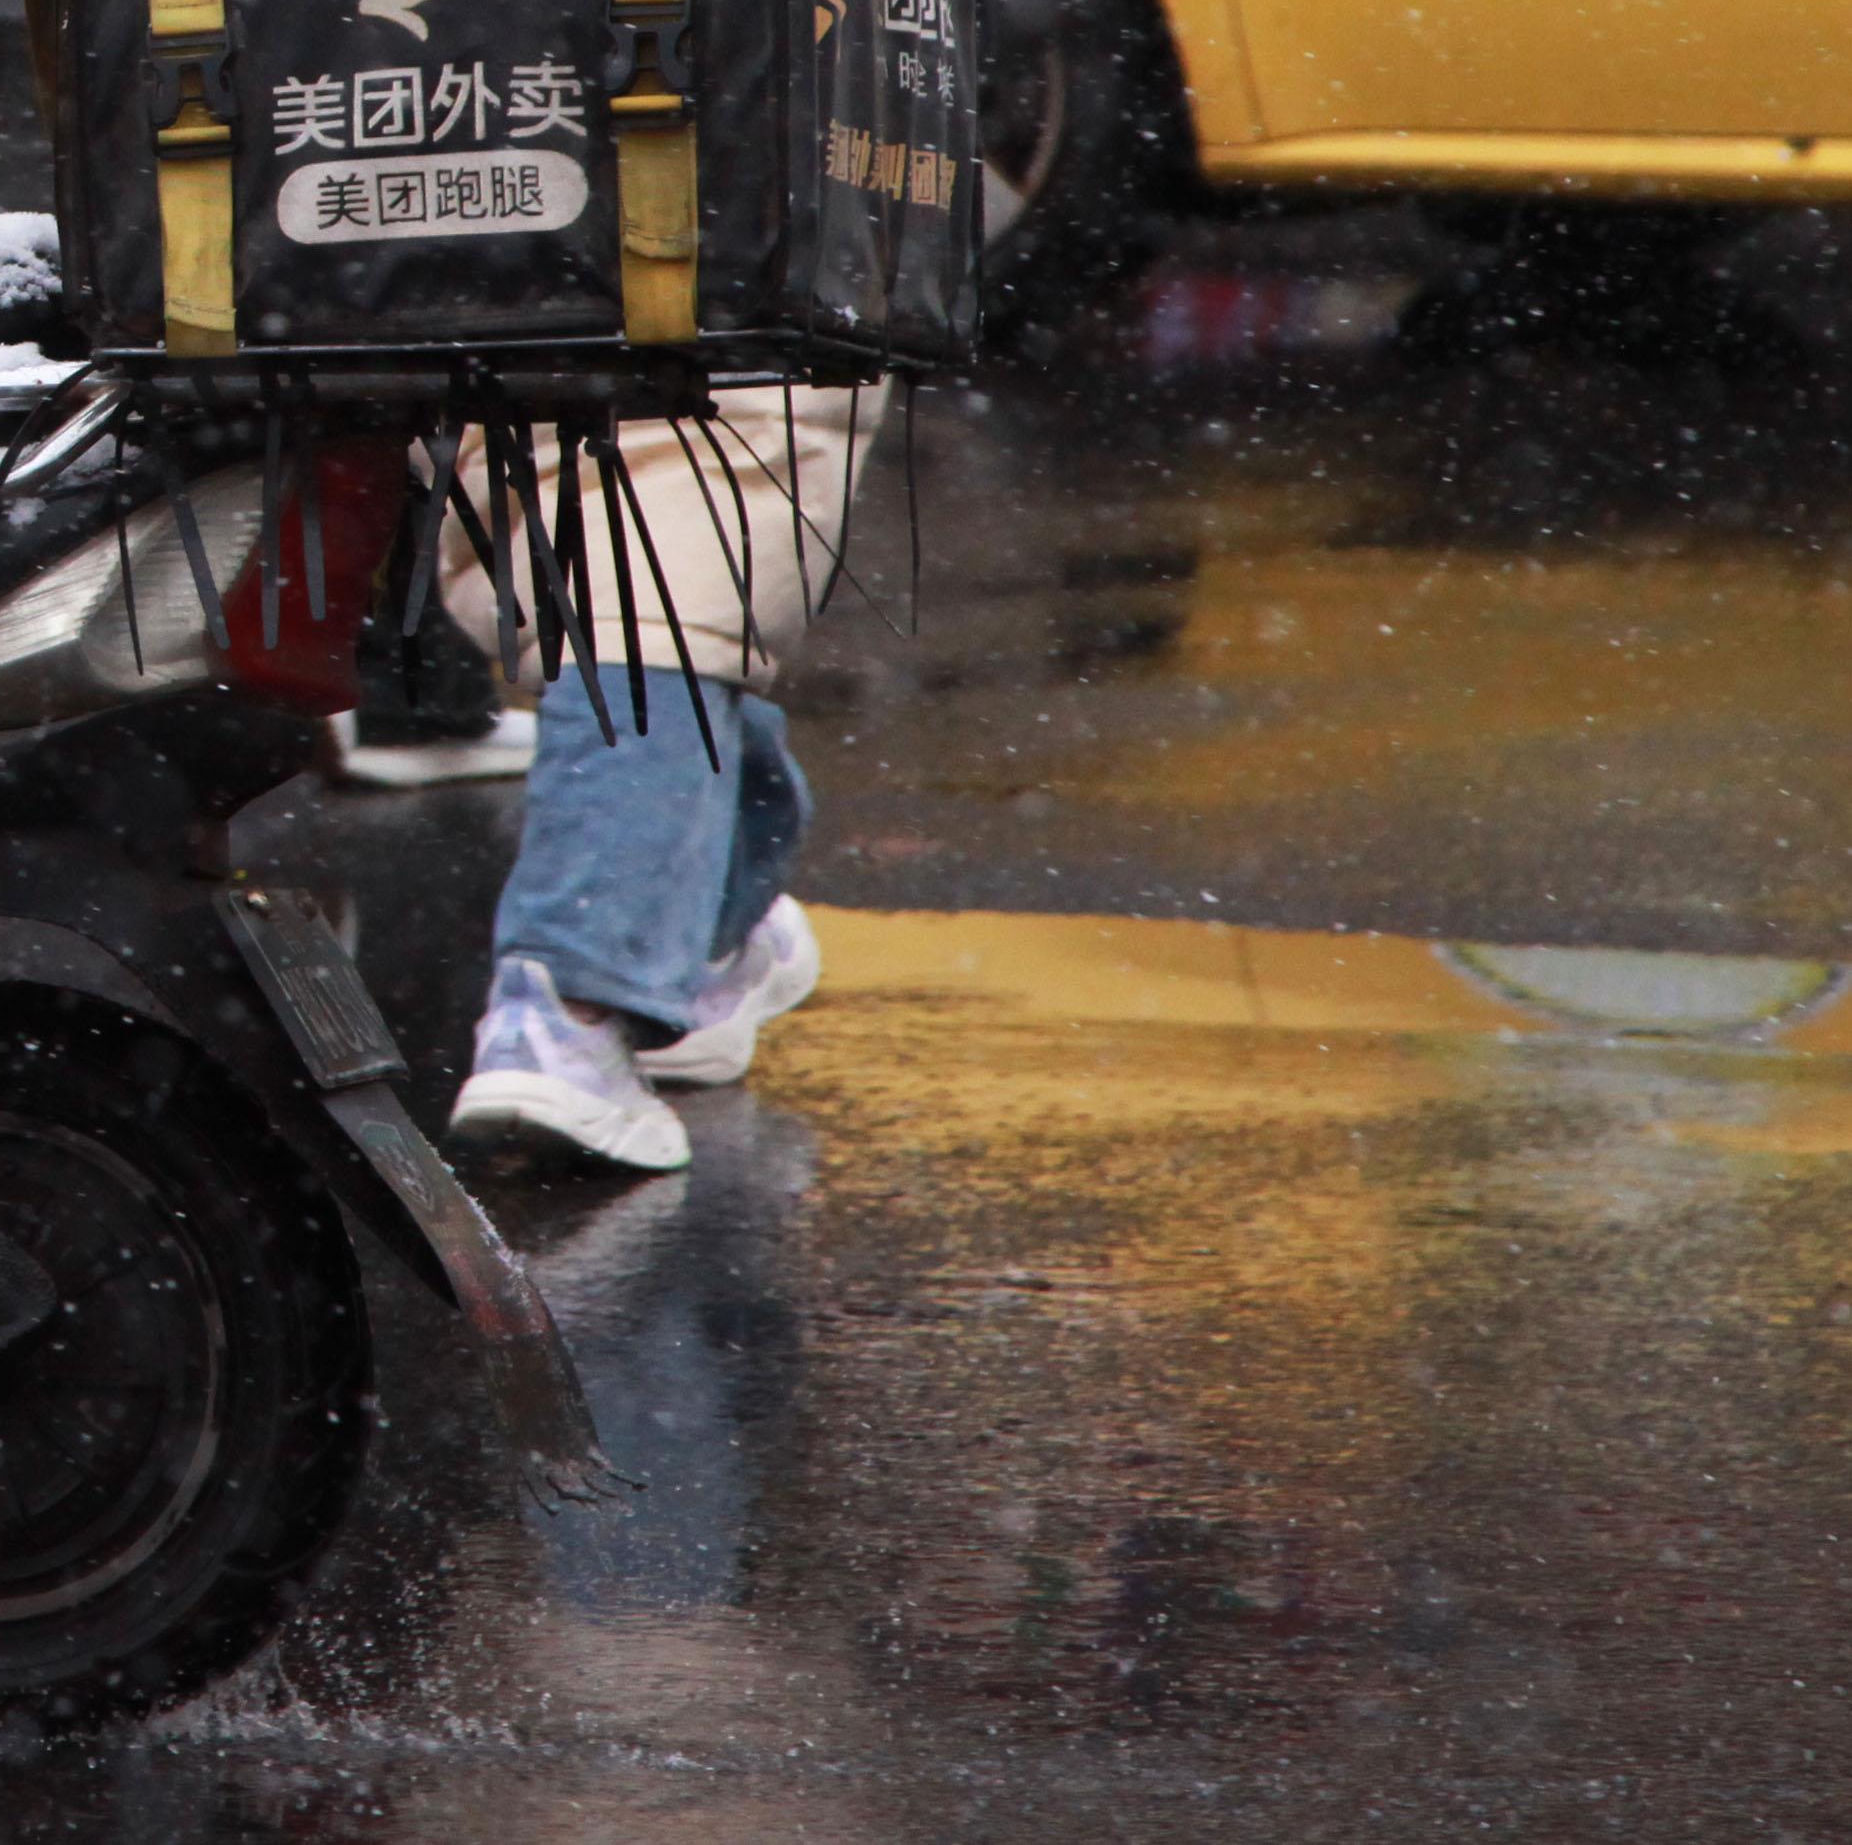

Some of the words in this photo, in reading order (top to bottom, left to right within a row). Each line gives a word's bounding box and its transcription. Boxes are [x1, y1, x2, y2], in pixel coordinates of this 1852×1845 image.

[272, 60, 587, 155] 美团外卖
[316, 165, 545, 230] 美团跑腿
